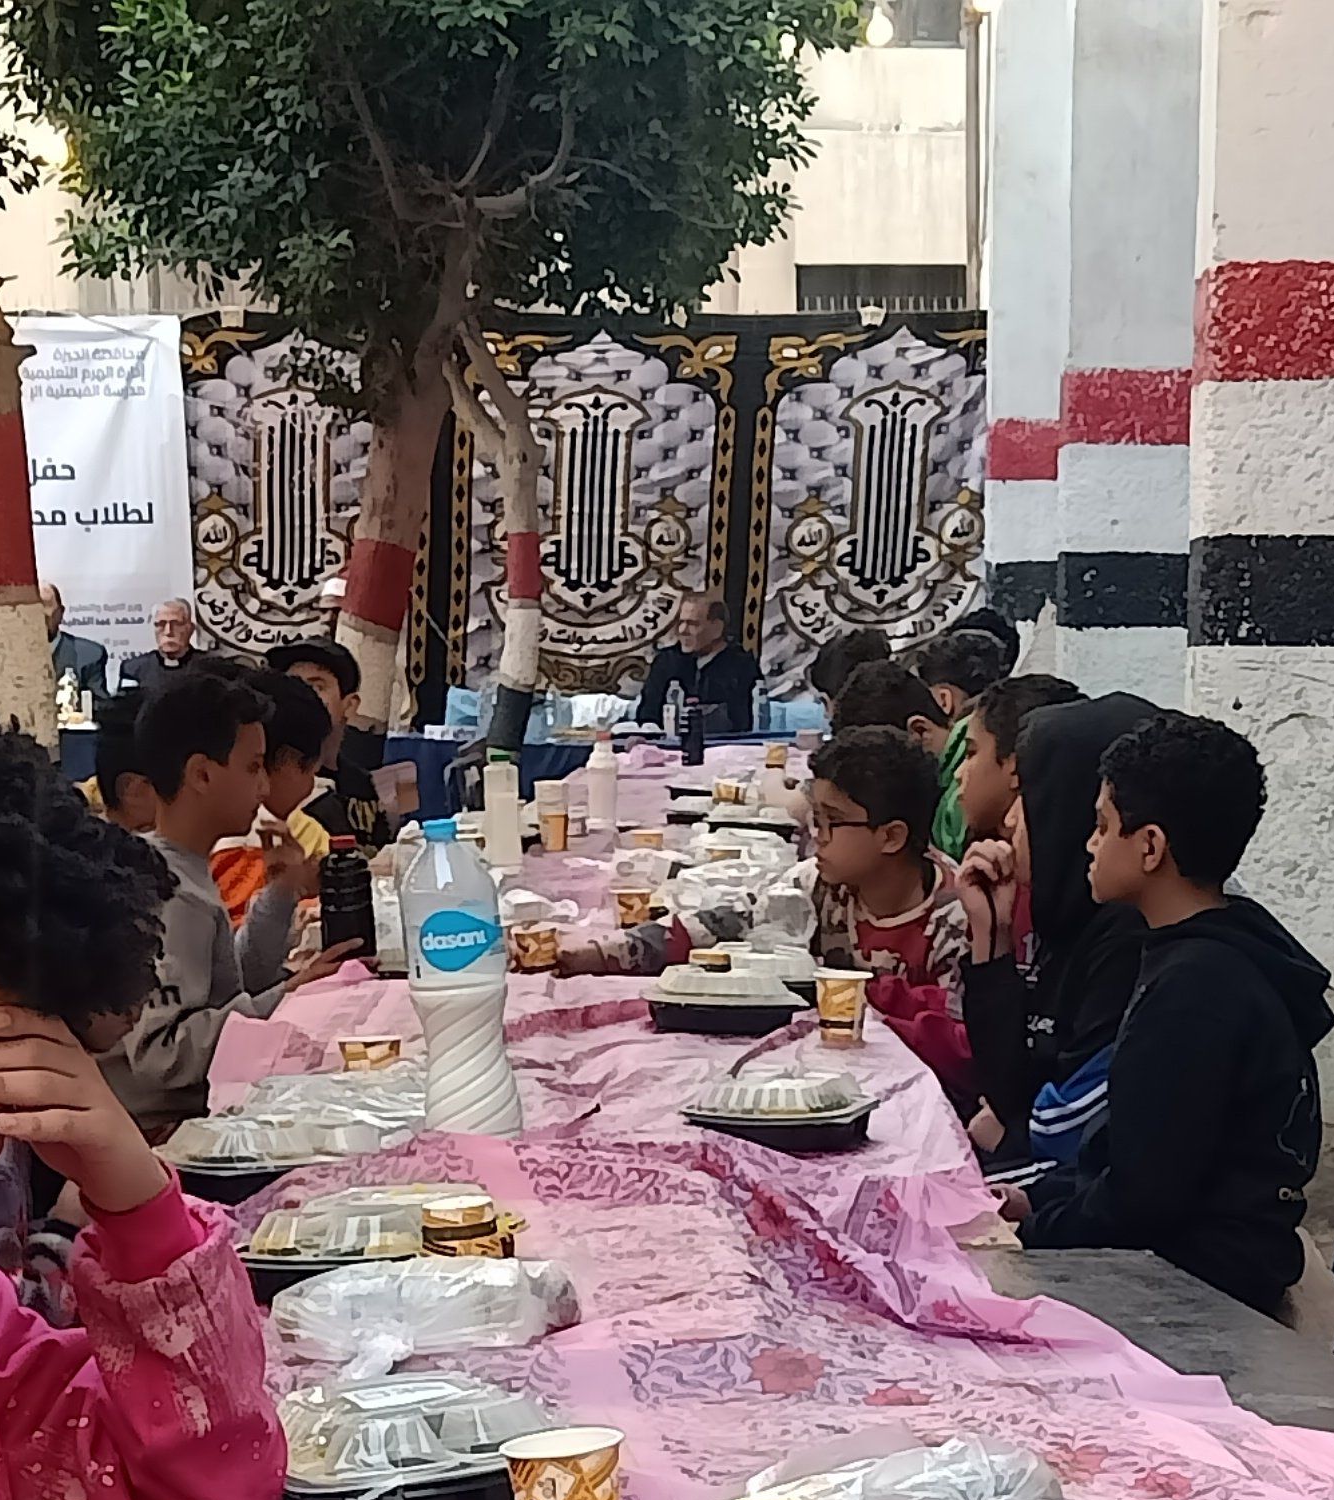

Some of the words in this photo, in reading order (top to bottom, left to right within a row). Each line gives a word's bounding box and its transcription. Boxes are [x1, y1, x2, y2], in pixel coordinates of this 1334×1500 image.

[80, 365, 114, 383] الهرم
[31, 457, 76, 487] حفل
[75, 502, 154, 533] لطلاب
